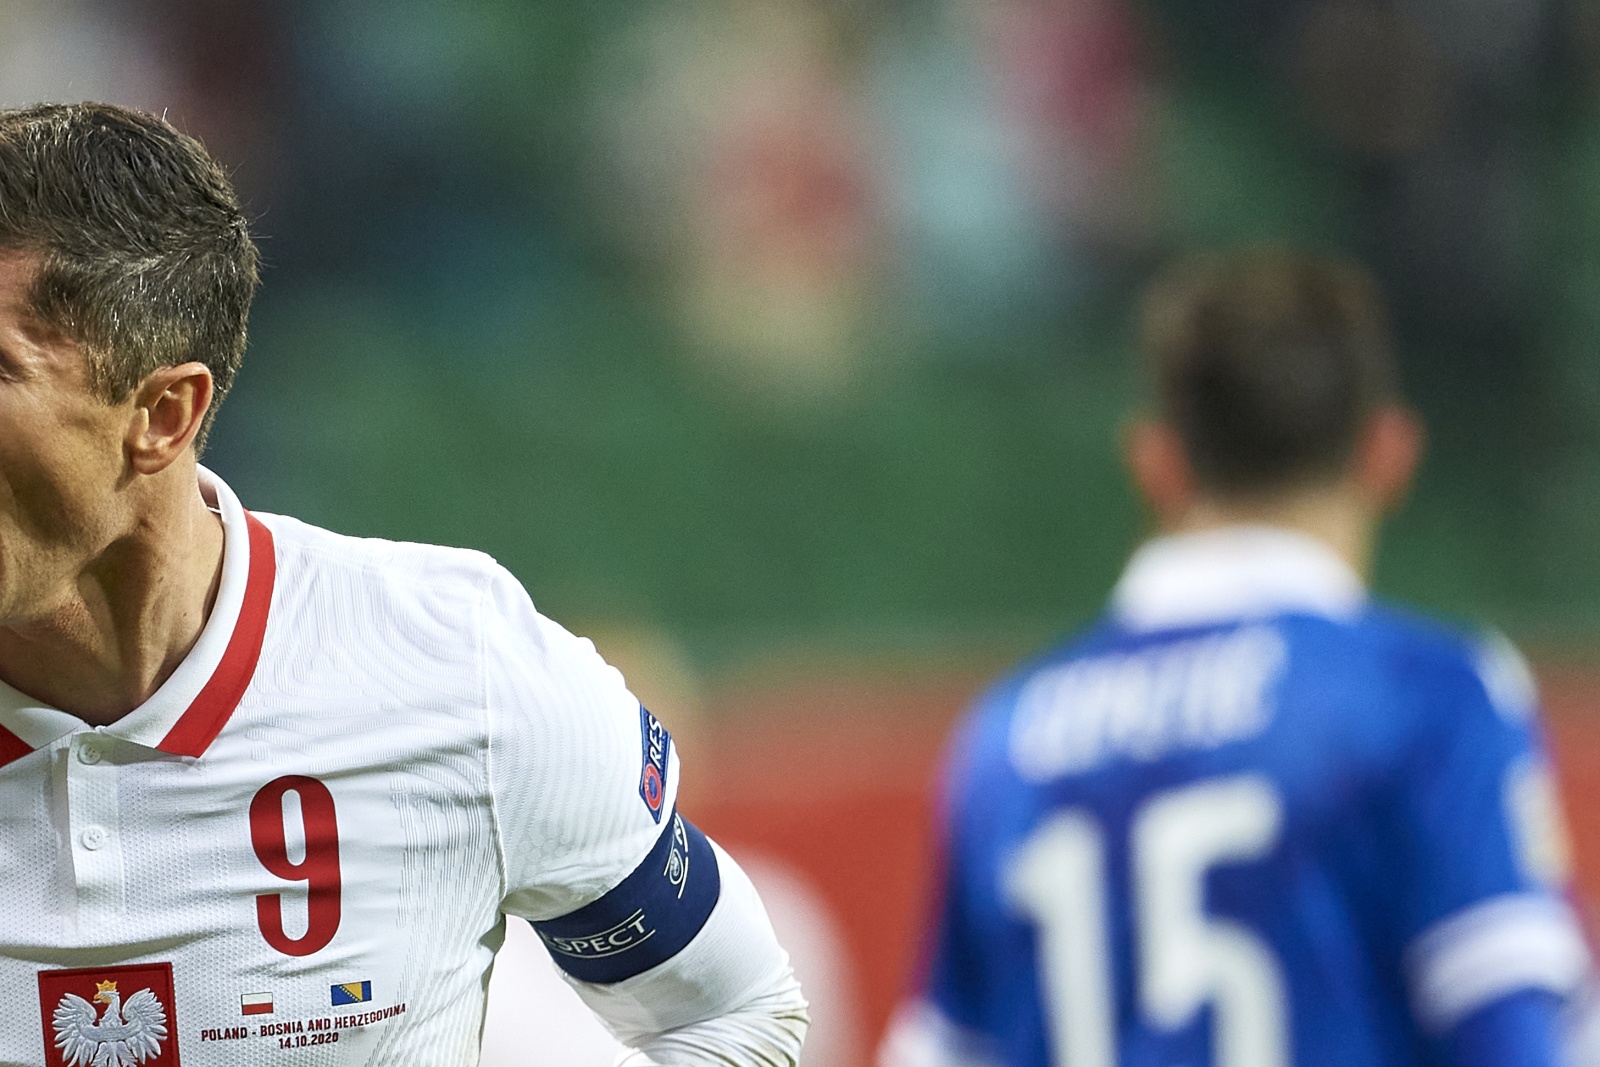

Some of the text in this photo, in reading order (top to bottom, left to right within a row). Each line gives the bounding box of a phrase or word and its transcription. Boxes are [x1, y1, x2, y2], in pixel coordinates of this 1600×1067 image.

[249, 774, 342, 957] 9
[541, 914, 645, 953] SPECT
[201, 1027, 248, 1042] POLAND
[260, 1020, 304, 1037] BOSNIA
[307, 1018, 331, 1032] AND
[334, 1003, 406, 1030] HERZEGOVINA
[279, 1032, 339, 1050] 14.10.2020
